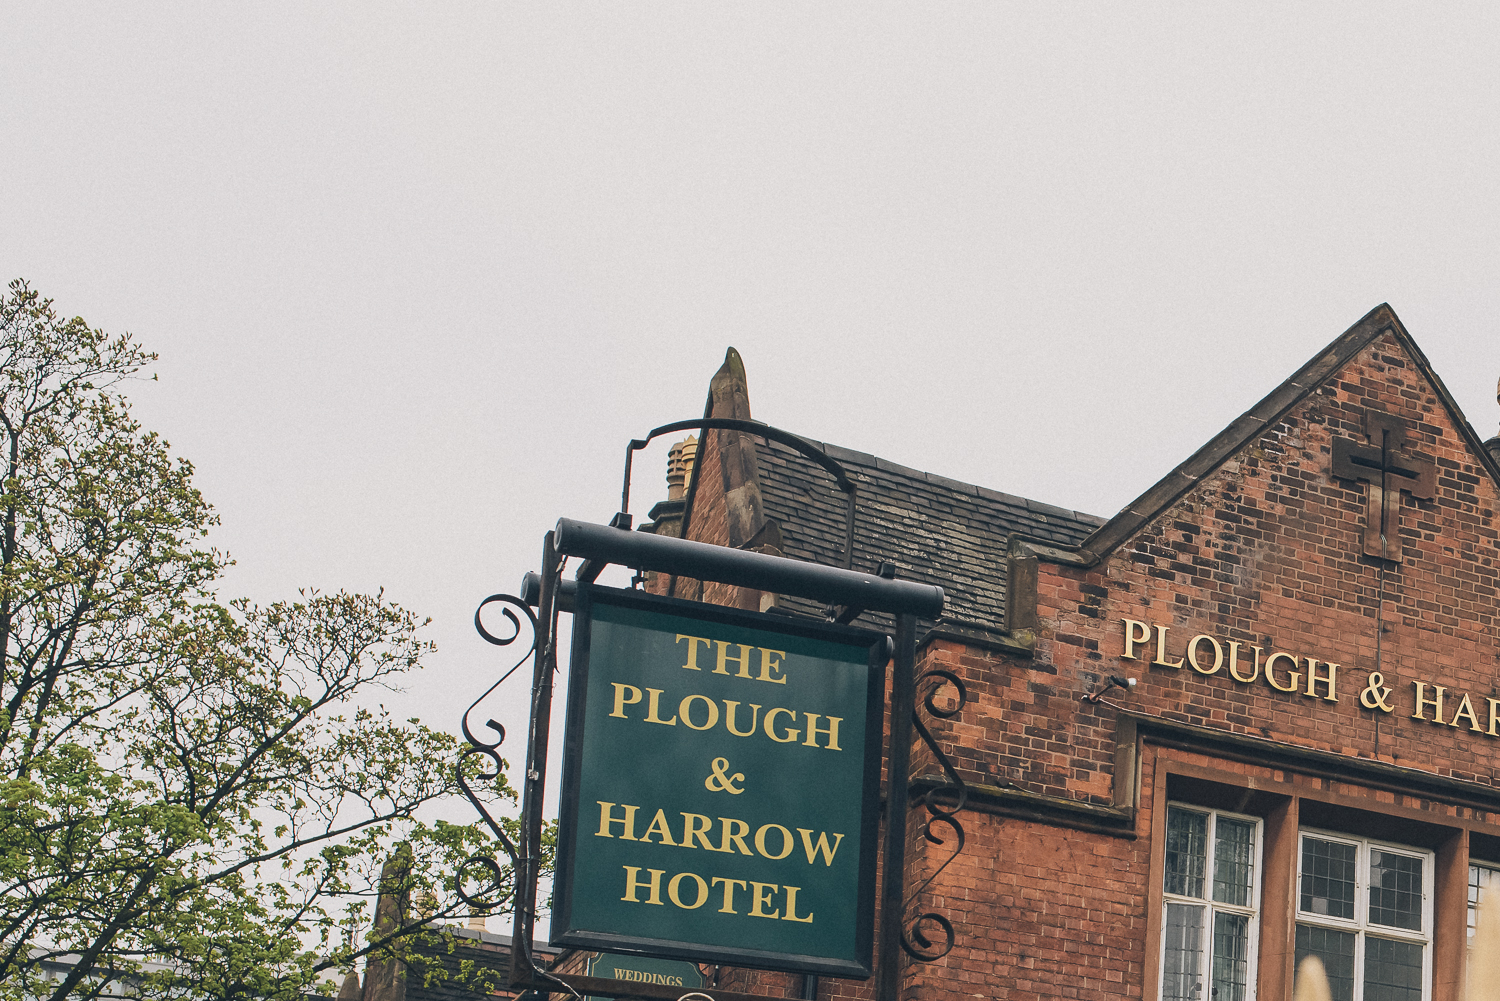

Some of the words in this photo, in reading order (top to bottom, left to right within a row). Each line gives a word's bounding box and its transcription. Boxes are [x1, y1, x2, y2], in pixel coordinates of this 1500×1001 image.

[675, 633, 788, 685] THE
[1120, 617, 1341, 702] PLOUGH
[1360, 671, 1395, 713] &
[608, 682, 844, 751] PLOUGH
[704, 756, 745, 795] &
[594, 800, 845, 867] HARROW
[620, 865, 814, 924] HOTEL
[613, 967, 683, 987] WEDDINGS
